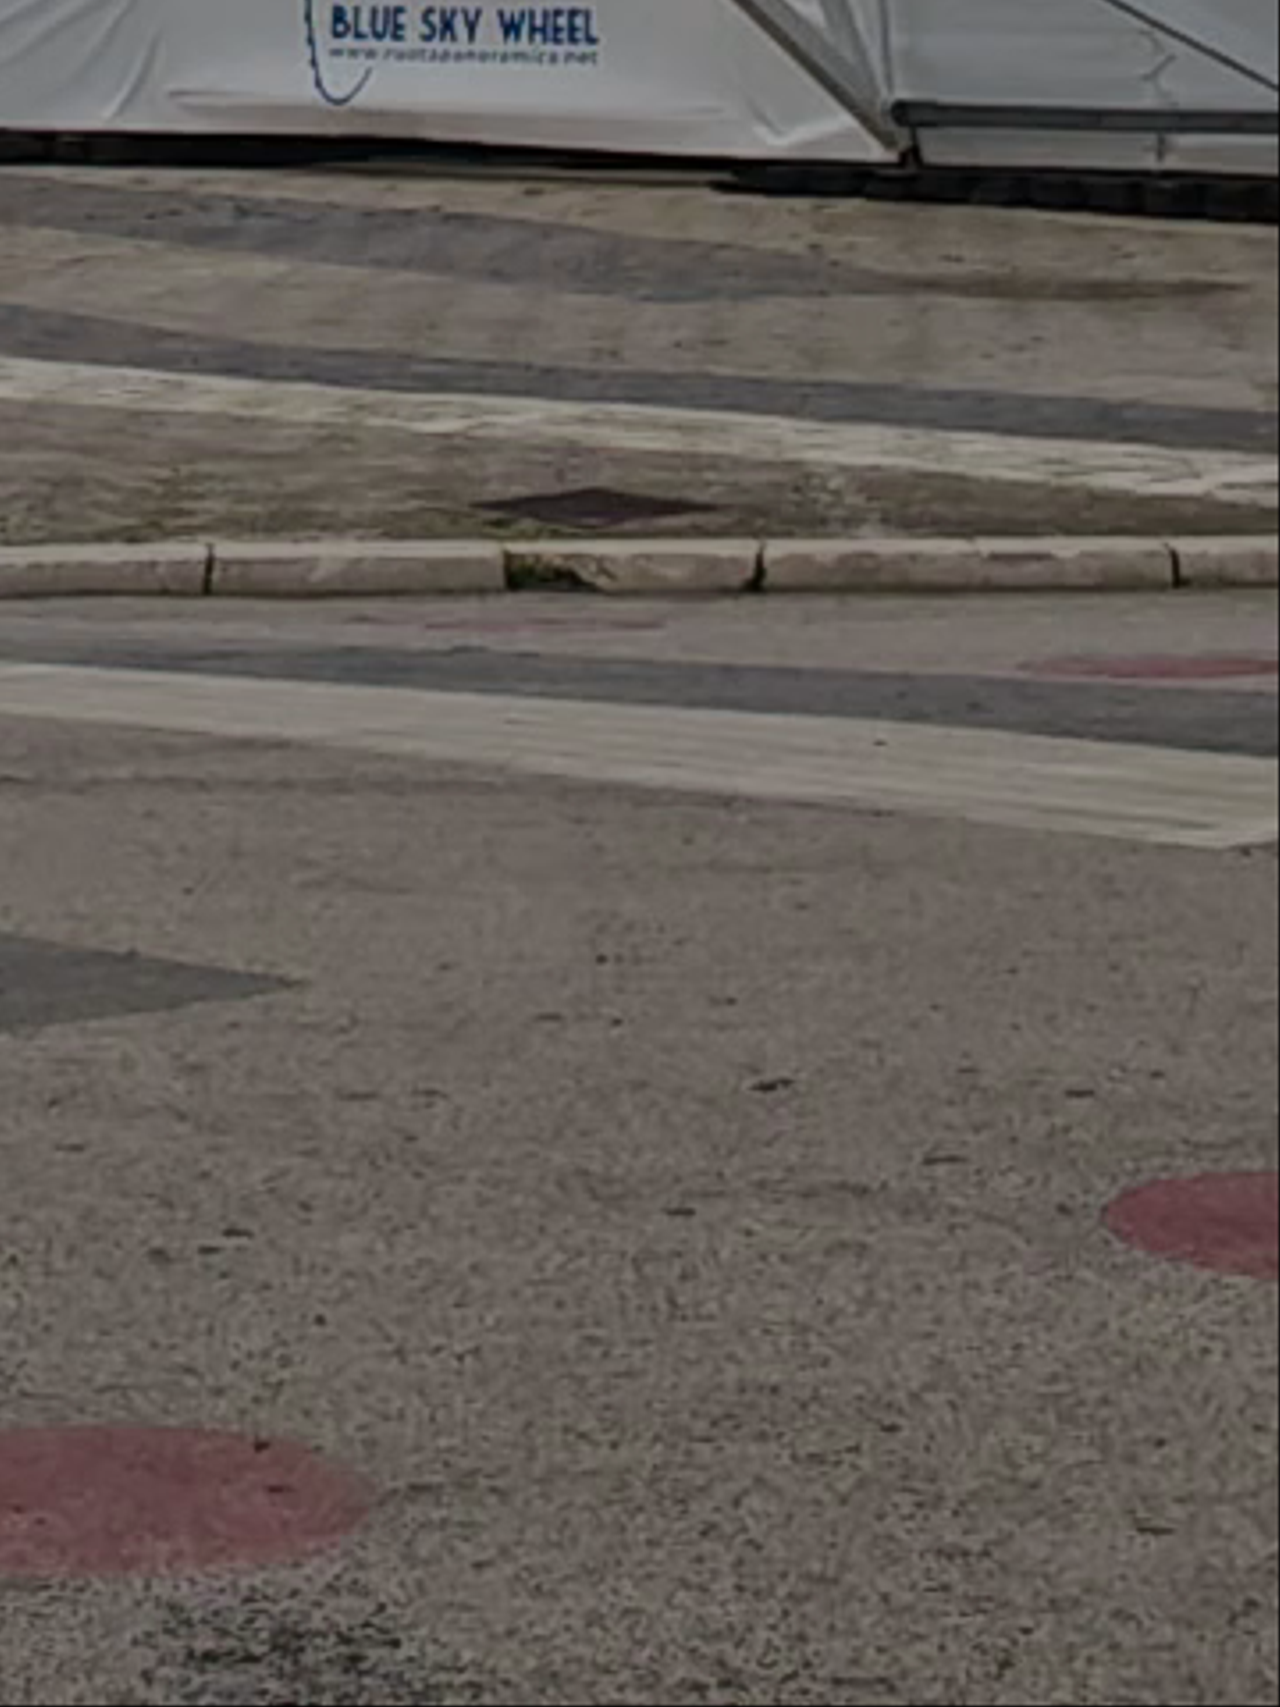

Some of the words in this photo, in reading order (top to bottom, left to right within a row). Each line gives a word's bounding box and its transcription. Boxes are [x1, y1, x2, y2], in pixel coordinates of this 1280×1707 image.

[330, 5, 406, 41] BLUE
[419, 6, 482, 44] SKY
[497, 7, 599, 45] WHEEL
